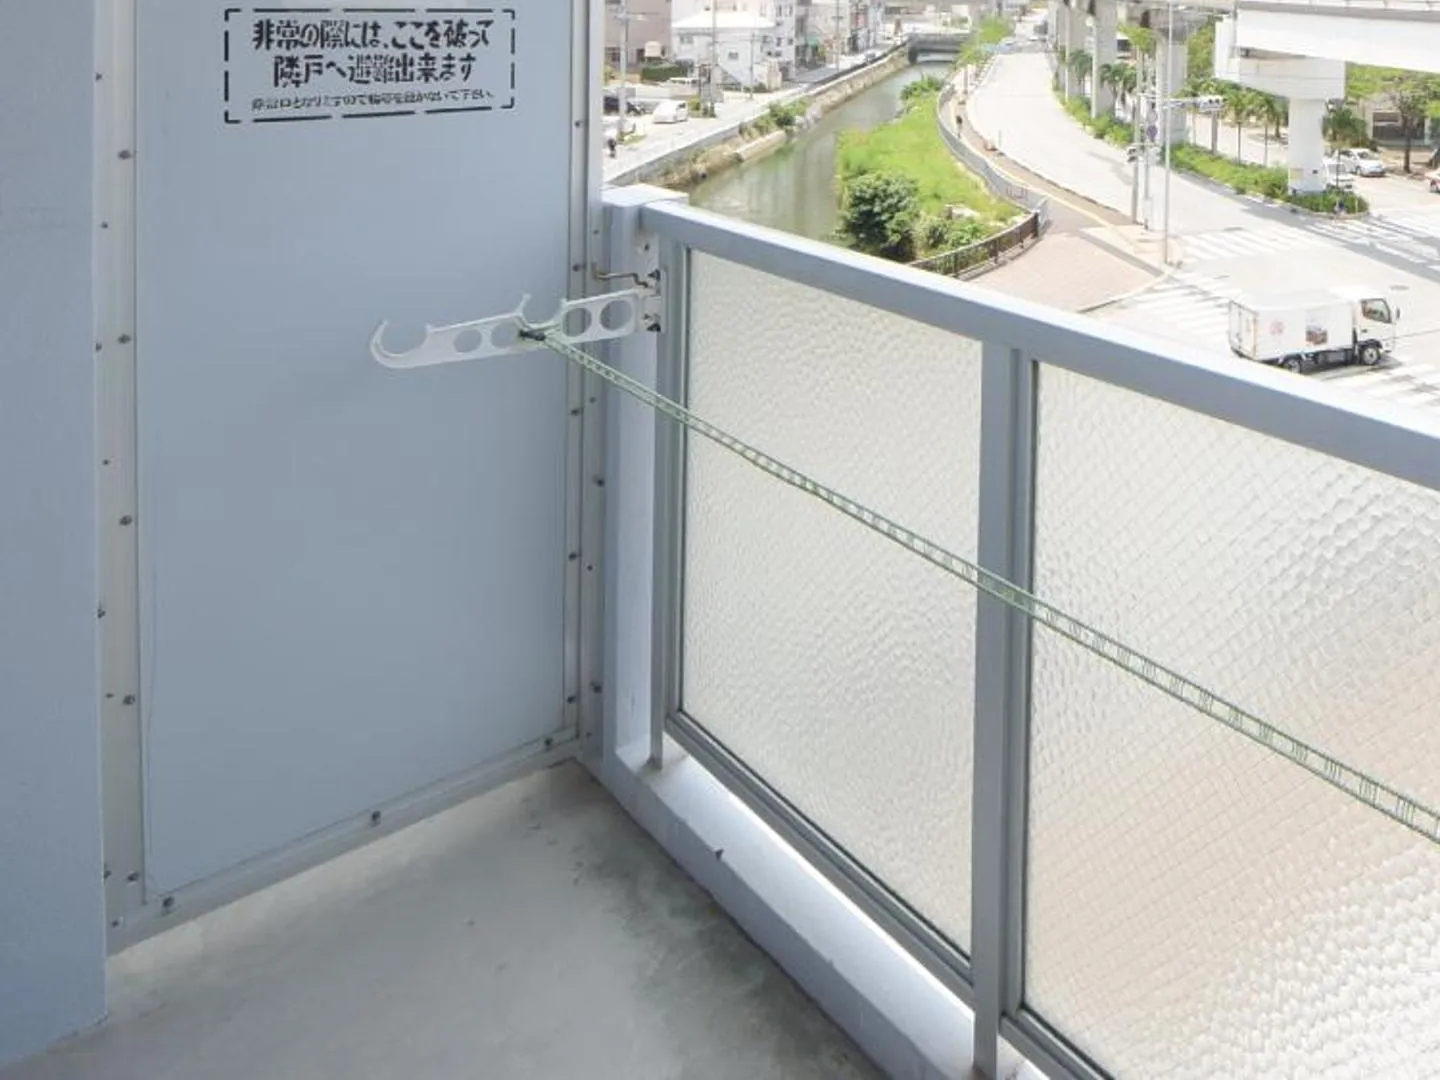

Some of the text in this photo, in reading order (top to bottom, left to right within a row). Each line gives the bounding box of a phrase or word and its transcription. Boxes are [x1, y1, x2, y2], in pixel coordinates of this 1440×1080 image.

[252, 19, 495, 50] 非常の際には、ここを破って
[273, 51, 477, 87] 隣戸へ避難出来ます
